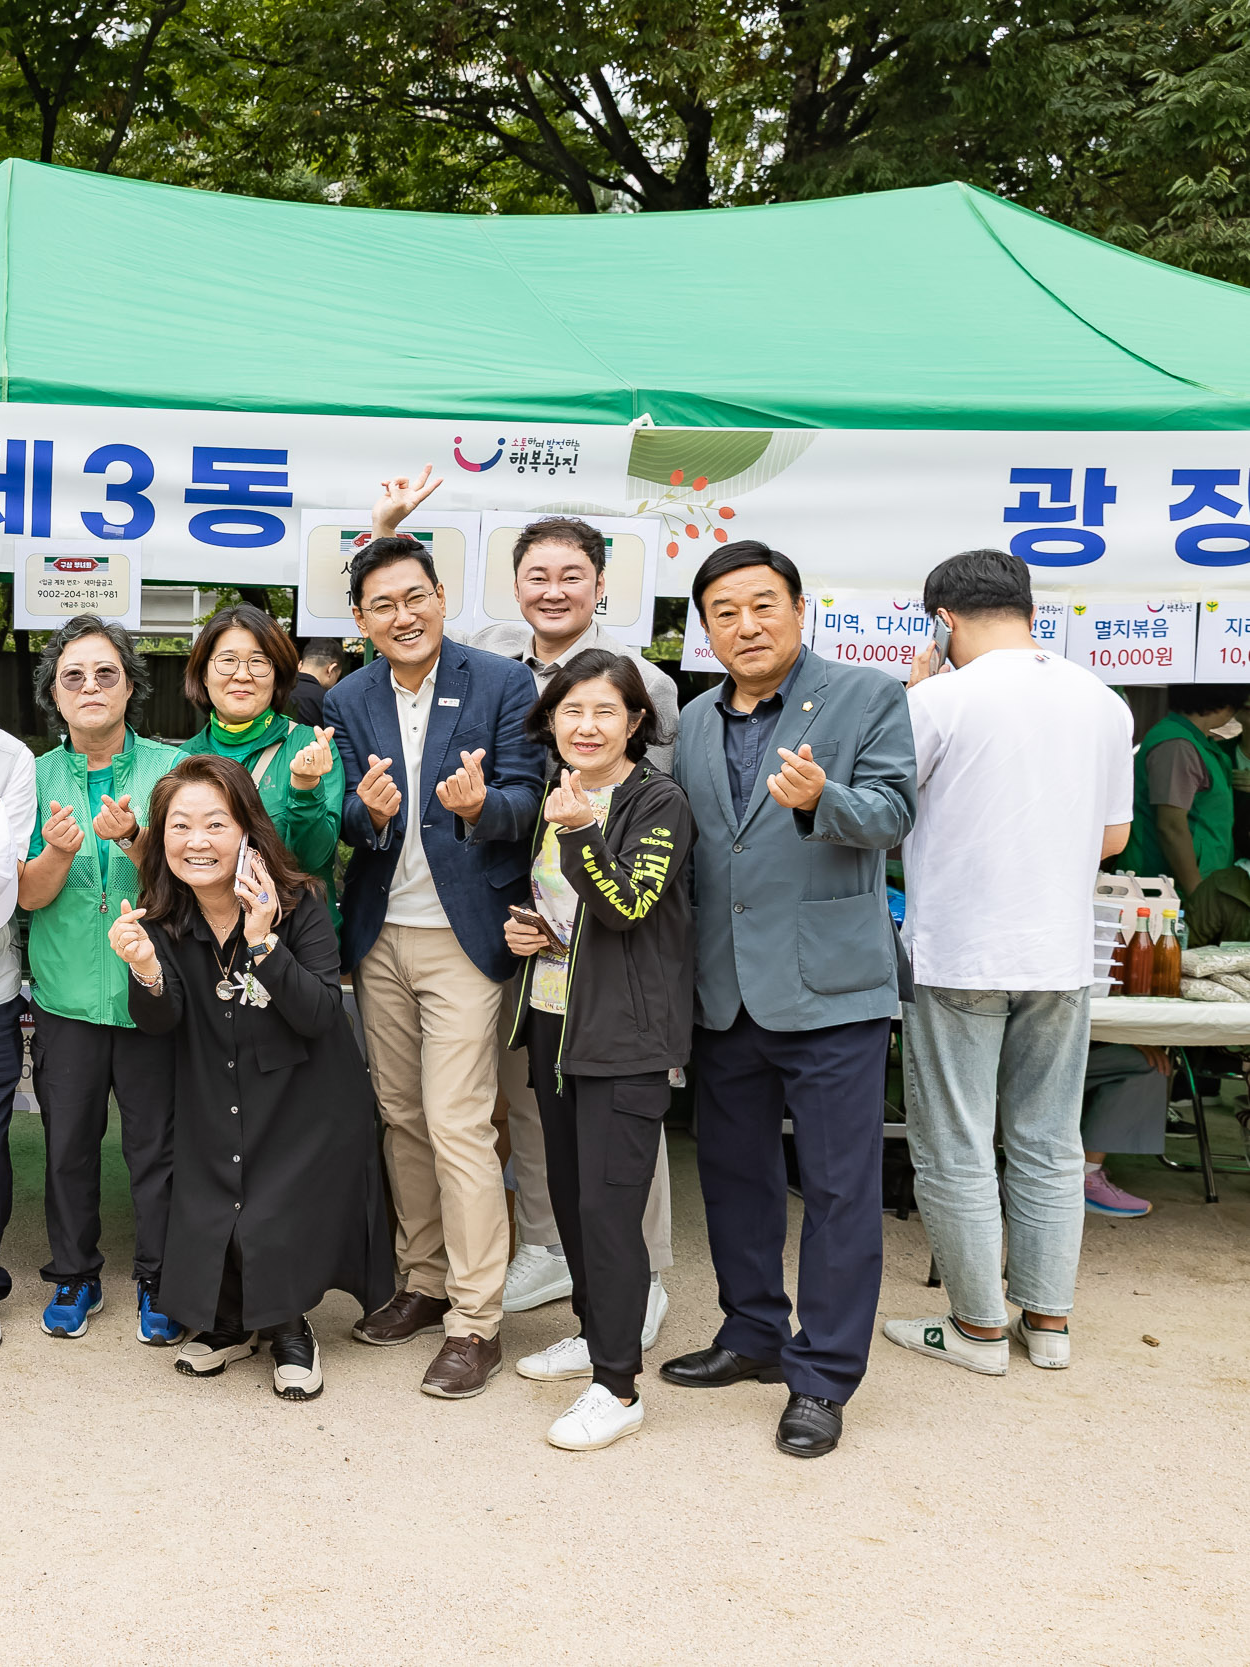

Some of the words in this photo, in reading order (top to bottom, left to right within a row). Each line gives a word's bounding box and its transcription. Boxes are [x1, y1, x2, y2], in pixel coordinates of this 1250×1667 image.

[511, 437, 545, 451] 소통하며
[546, 439, 580, 452] 발전하는
[509, 450, 578, 475] 행복광진
[37, 590, 118, 599] 9002-204-181-981
[825, 613, 864, 635] 미역,
[876, 616, 931, 637] 다시마
[1095, 618, 1169, 640] 멸치볶음
[835, 643, 916, 665] 10,000원
[1089, 646, 1173, 669] 10,000원
